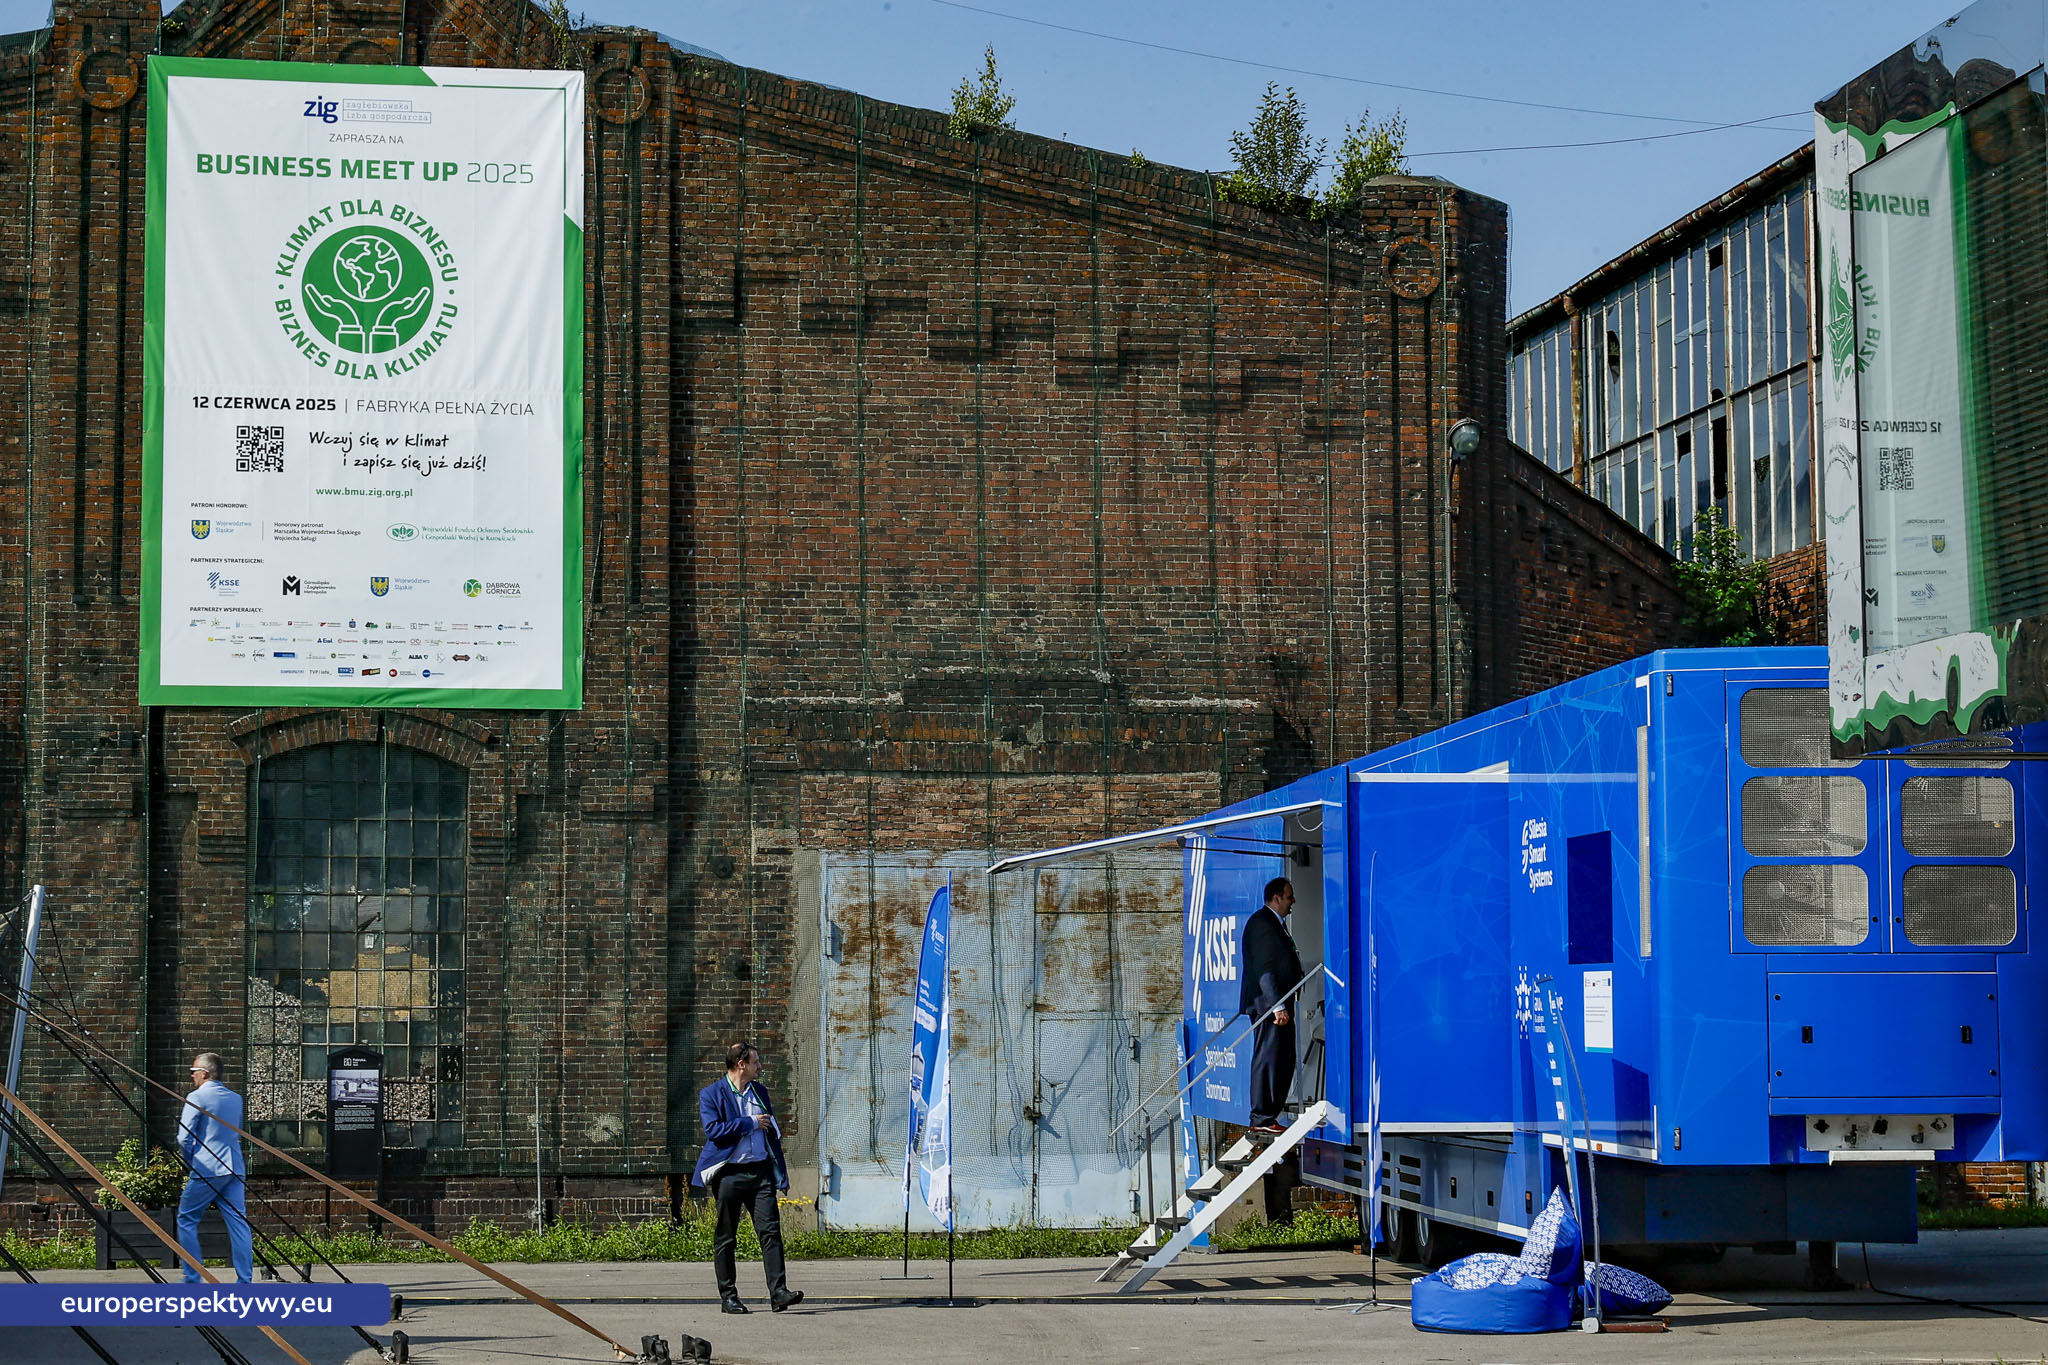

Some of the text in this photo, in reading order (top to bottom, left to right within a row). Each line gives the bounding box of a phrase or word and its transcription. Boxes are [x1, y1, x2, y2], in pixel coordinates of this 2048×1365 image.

[303, 95, 339, 124] zig
[345, 101, 409, 111] zagłębiowska
[346, 112, 429, 122] izba gospodarcza
[328, 133, 404, 144] ZAPRASZA NA
[196, 153, 534, 184] BUSINESS MEET UP 2025
[275, 199, 459, 282] KLIMAT DLA BIZNESU
[274, 298, 459, 380] BIZNES DLA KLIMATU
[192, 396, 337, 411] 12 CZERWCA 2025
[356, 400, 535, 416] FABRYKA PEŁNA ŻYCIA
[309, 431, 450, 453] Wczuj się w klimat
[343, 454, 487, 477] i zapisz się już dziś!
[315, 487, 413, 498] www.bmu.zig.org.pl
[1528, 816, 1548, 840] Silesia
[1528, 842, 1546, 864] Smart
[1528, 868, 1554, 894] Systems
[1204, 914, 1237, 982] KSSE
